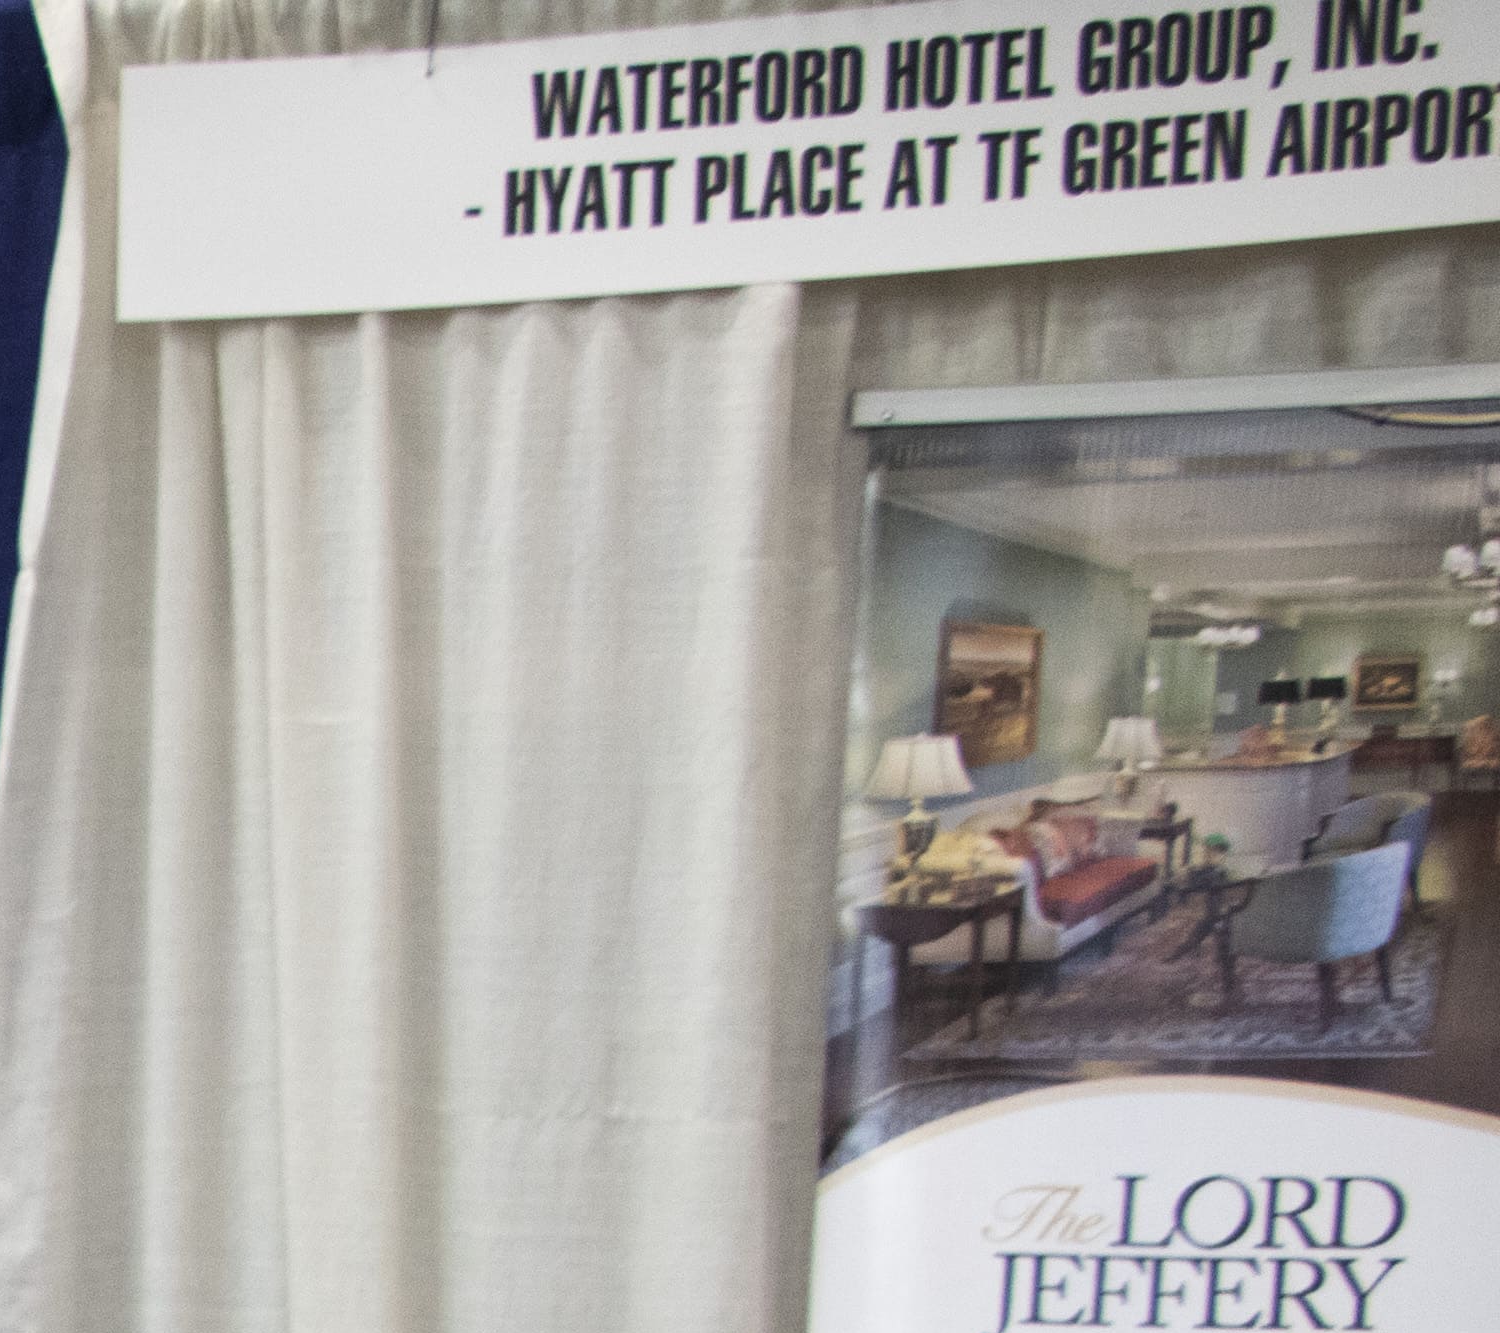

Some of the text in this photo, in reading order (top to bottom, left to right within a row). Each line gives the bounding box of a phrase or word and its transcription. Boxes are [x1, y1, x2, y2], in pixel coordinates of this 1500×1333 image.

[531, 0, 1439, 140] WATERFORD HOTEL GROUP, INC.
[502, 158, 676, 237] HYATT
[693, 143, 866, 224] PLACE
[882, 134, 960, 210] AT
[977, 126, 1043, 202] TF
[1061, 108, 1249, 196] GREEN
[1266, 82, 1500, 178] AIRPOR
[982, 1174, 1407, 1251] The LORD
